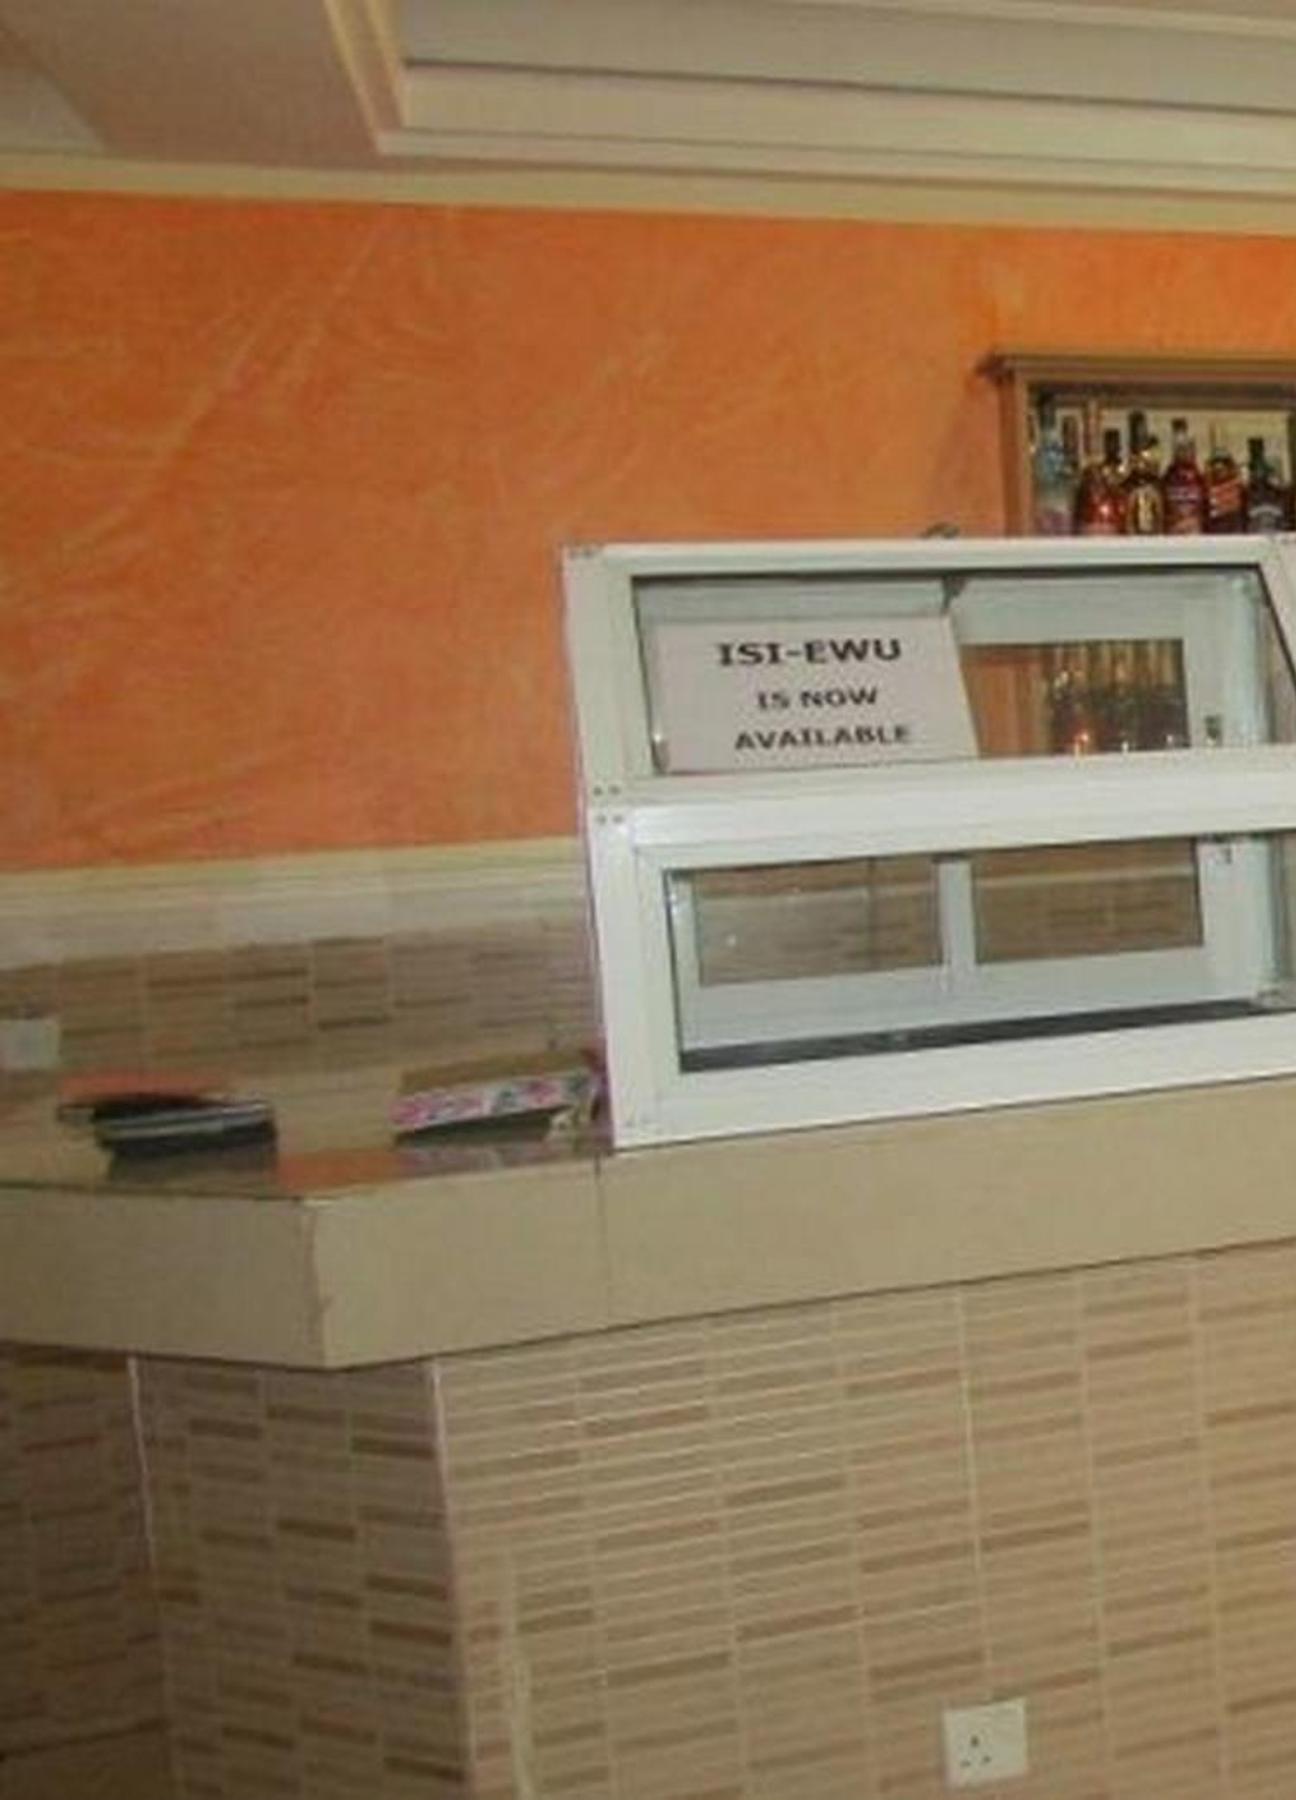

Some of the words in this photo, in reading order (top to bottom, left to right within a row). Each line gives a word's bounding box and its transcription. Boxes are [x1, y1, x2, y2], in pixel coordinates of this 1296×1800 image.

[718, 638, 901, 666] ISI-EWU
[757, 692, 790, 710] IS
[801, 687, 878, 709] NOW
[734, 725, 910, 750] AVAILABLE
